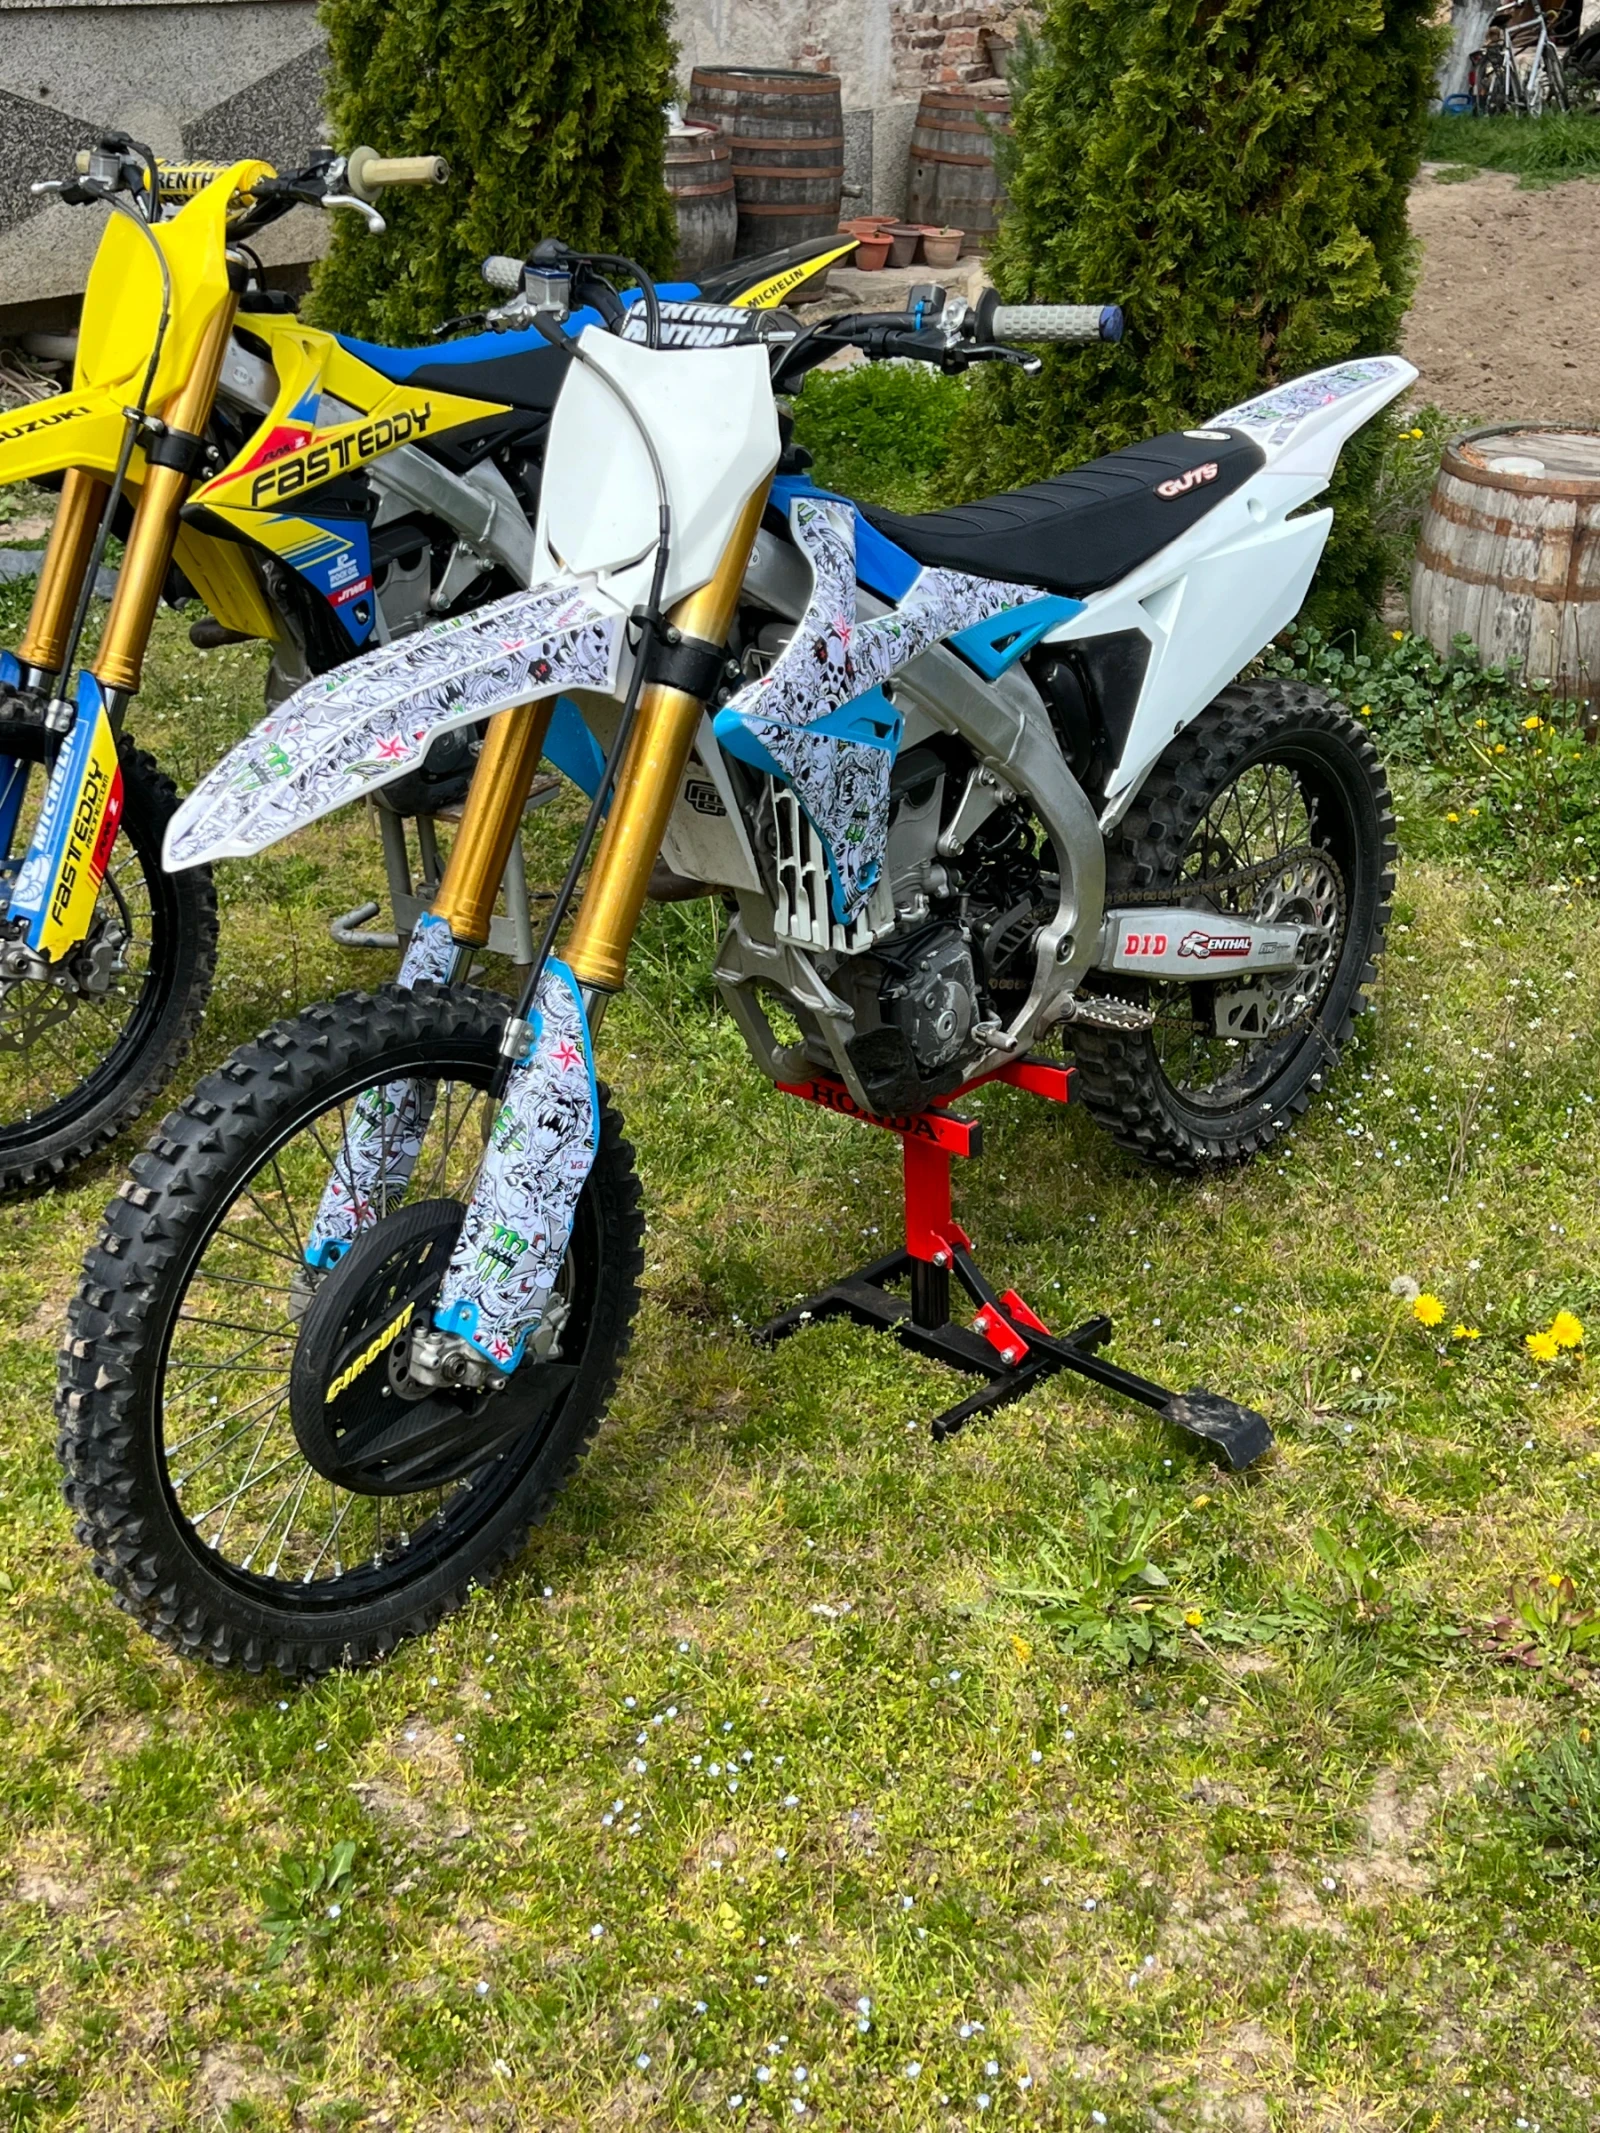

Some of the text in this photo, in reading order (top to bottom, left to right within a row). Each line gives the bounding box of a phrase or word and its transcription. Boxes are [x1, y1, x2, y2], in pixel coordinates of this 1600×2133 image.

[747, 269, 804, 308] MICHELIN
[0, 406, 92, 443] UZUKI
[1157, 462, 1218, 497] GUTS
[1178, 931, 1251, 959] RENTHAL
[324, 1301, 416, 1404] CIRCUIT
